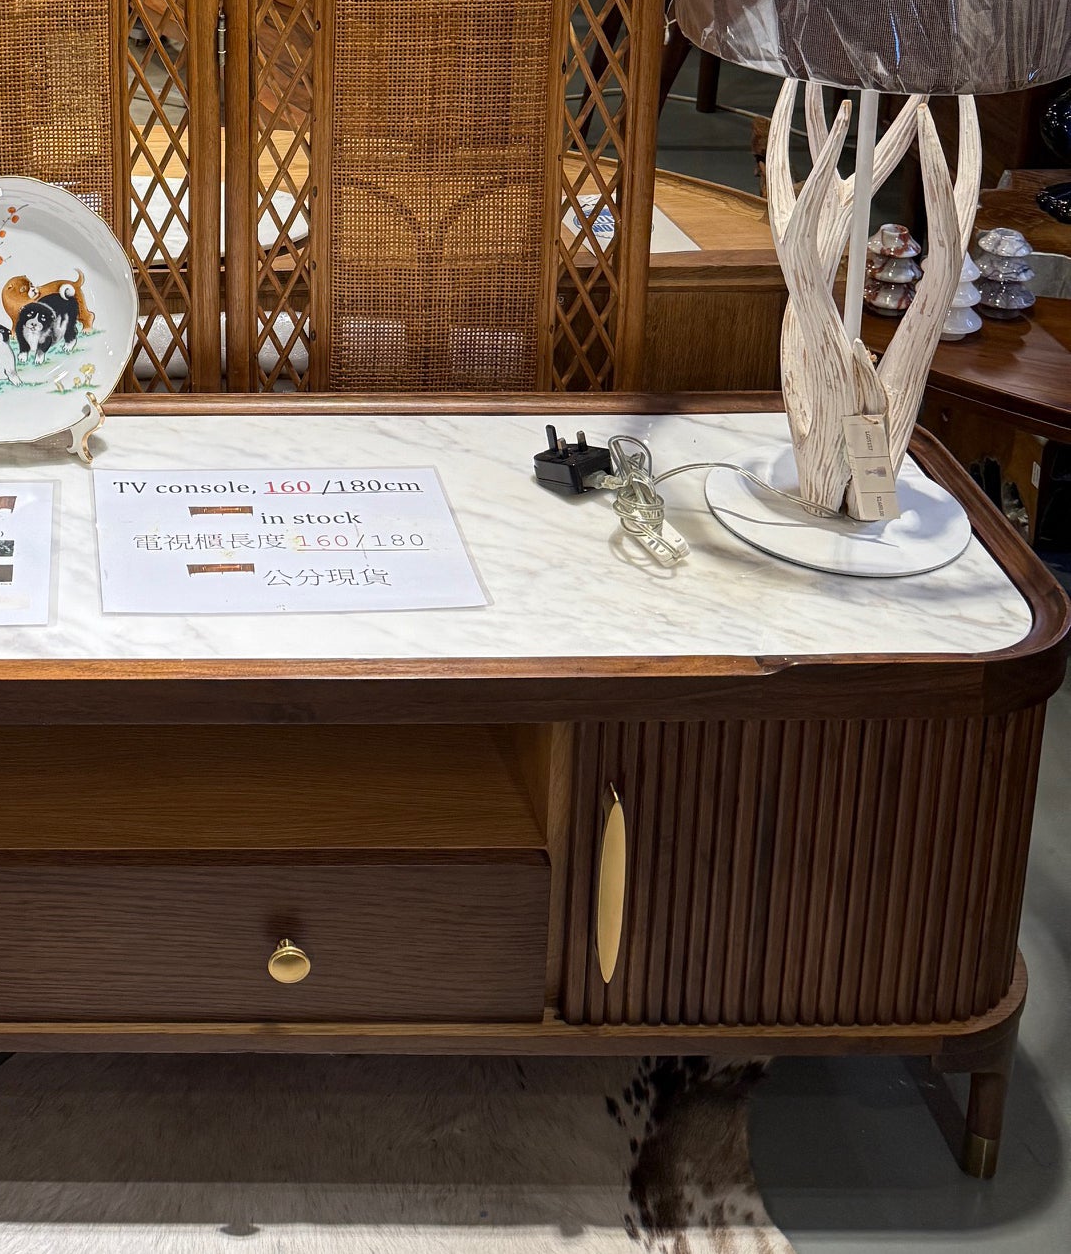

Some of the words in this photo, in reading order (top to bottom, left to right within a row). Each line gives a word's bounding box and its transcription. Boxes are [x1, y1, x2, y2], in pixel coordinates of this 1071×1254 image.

[113, 481, 147, 494] TV
[155, 480, 257, 495] console,
[264, 480, 312, 494] 160
[320, 479, 422, 495] /180cm
[260, 512, 286, 524] in
[293, 511, 363, 525] stock
[132, 533, 288, 550] 電視櫃長度
[264, 568, 392, 587] 公分現貨
